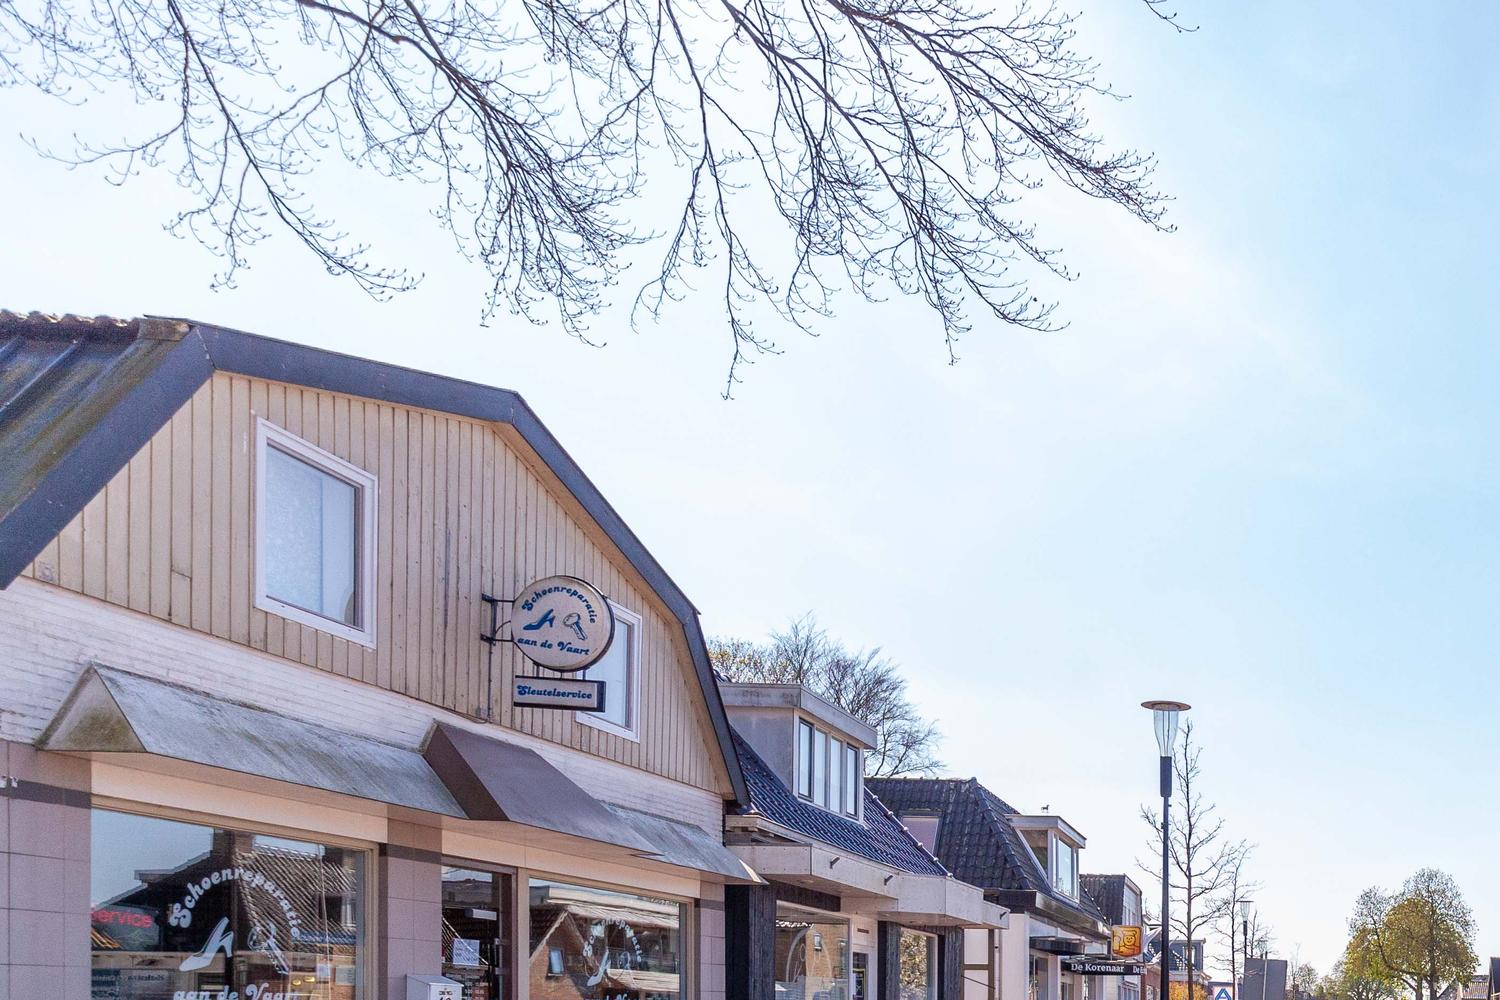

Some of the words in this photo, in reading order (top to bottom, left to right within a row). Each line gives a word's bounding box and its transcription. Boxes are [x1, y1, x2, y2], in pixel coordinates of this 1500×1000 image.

[521, 586, 598, 624] Schoenreparatie
[517, 638, 538, 648] aan
[540, 640, 553, 650] de
[557, 641, 590, 656] Vaart
[517, 685, 593, 700] Sleutelservice
[168, 867, 301, 939] Schoenreparatie
[1071, 963, 1083, 971] De
[1085, 963, 1125, 973] Korenaar
